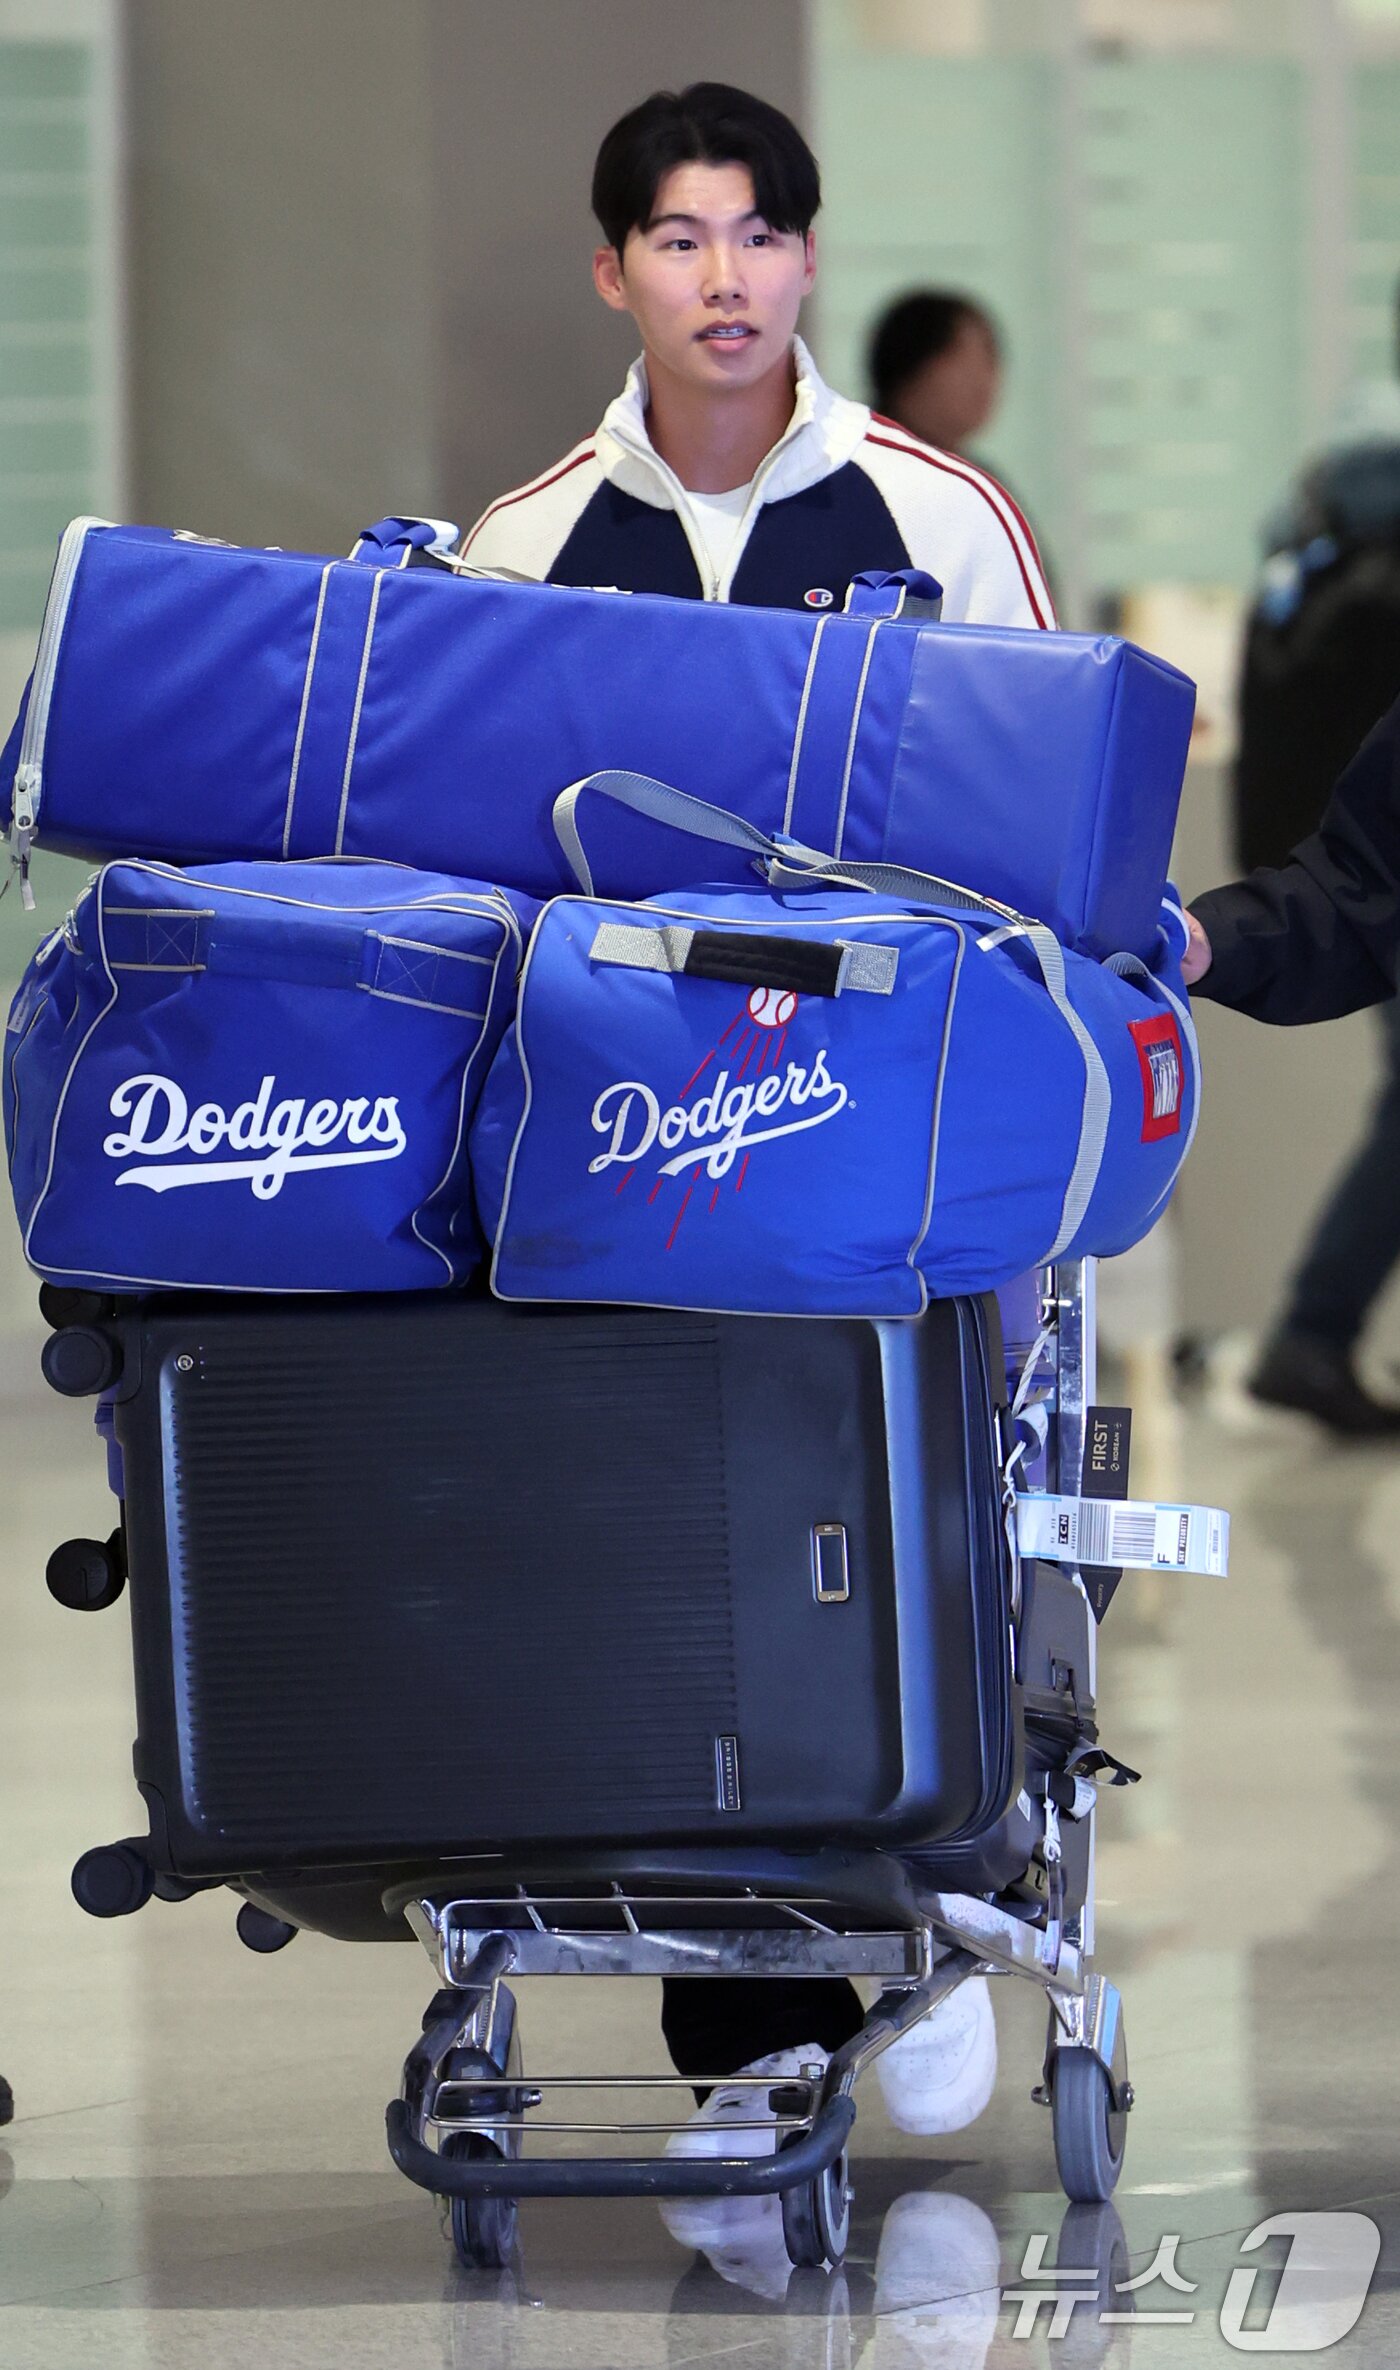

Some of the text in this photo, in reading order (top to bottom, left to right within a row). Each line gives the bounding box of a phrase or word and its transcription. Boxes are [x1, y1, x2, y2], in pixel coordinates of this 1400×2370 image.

[588, 1049, 847, 1179] Dodgers
[103, 1074, 407, 1200] Dodgers
[1092, 1419, 1108, 1470] FIRST
[1112, 1431, 1120, 1461] KOREAN
[1059, 1516, 1068, 1543] ICN
[1157, 1553, 1170, 1563] F
